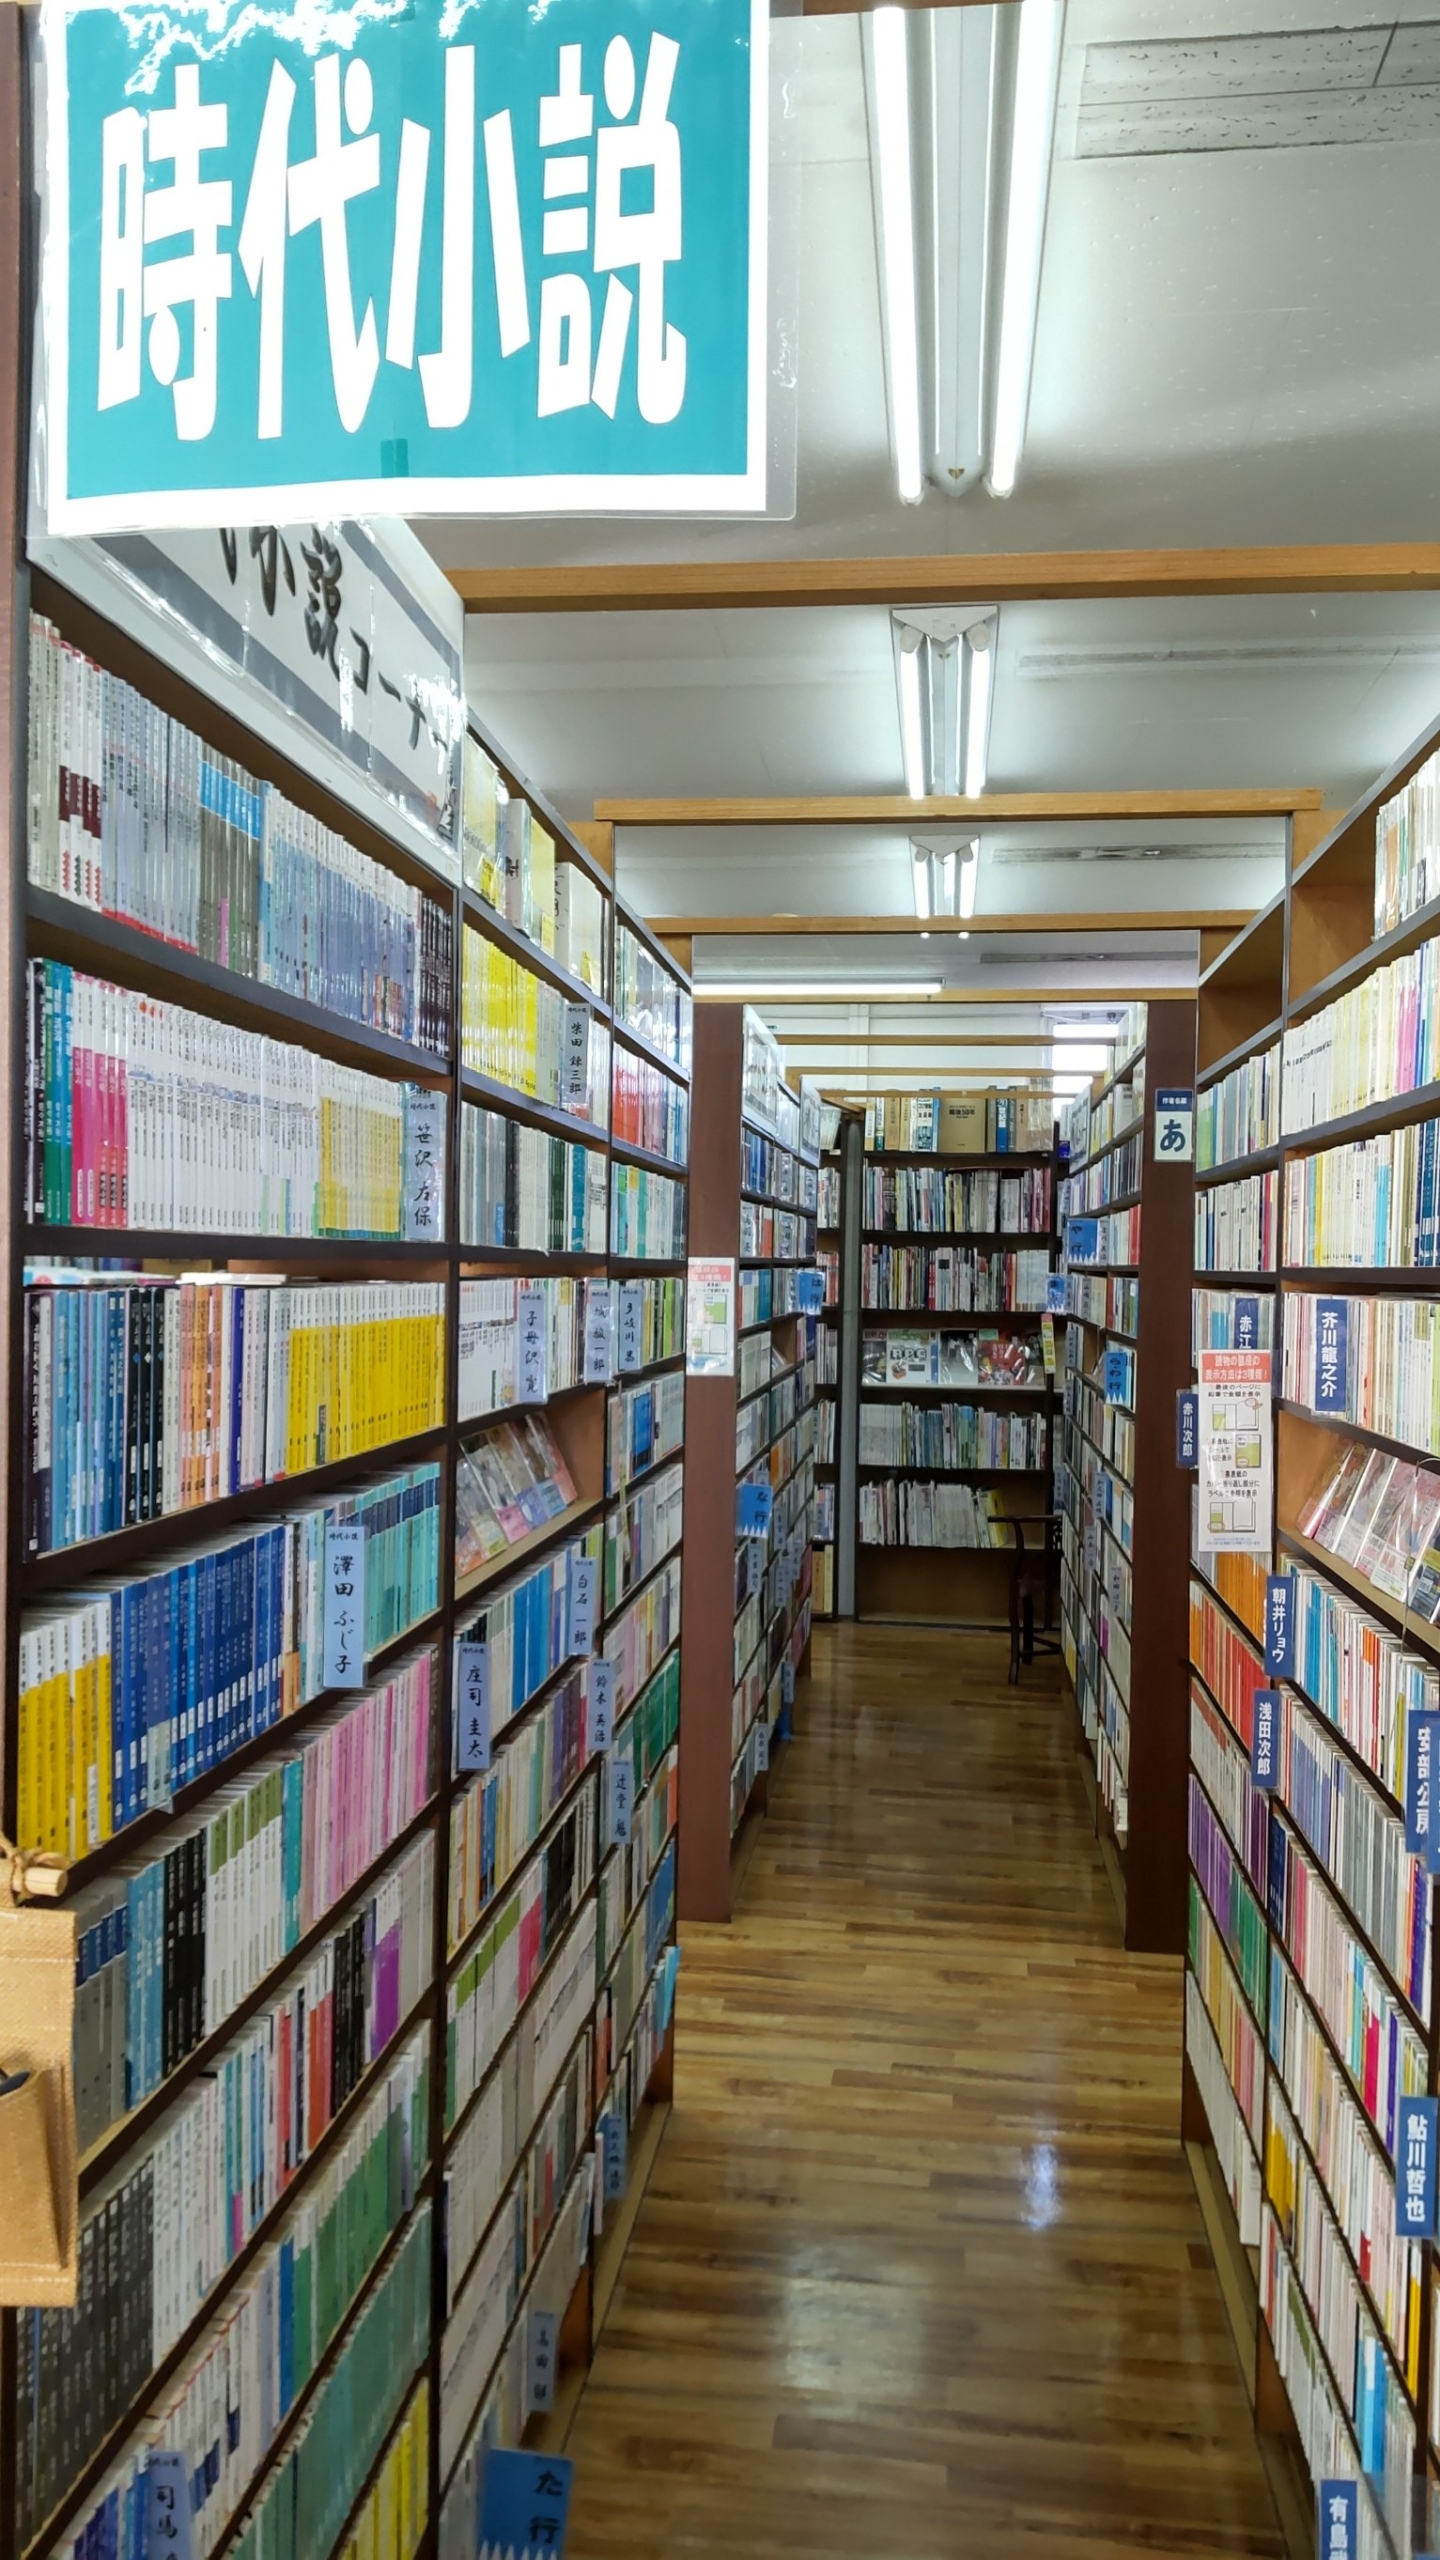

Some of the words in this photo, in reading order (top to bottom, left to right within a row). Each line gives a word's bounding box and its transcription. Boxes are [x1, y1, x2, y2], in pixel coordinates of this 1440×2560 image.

[97, 32, 686, 441] 時代小説
[1160, 1119, 1185, 1152] あ
[414, 1123, 433, 1226] 笹沢左保
[1072, 1224, 1083, 1252] や行
[1239, 1315, 1252, 1349] 赤江
[1321, 1311, 1338, 1398] 芥川龍之介
[1182, 1403, 1193, 1457] 赤川次郎
[754, 1490, 768, 1524] な行
[333, 1555, 355, 1674] 澤田ふじ子
[574, 1574, 588, 1645] 白石一郎
[1271, 1587, 1287, 1664] 朝井リョウ
[466, 1665, 484, 1758] 庄司圭太
[594, 1675, 608, 1744] 鈴木英治
[1257, 1701, 1273, 1776] 浅田次郎
[1405, 2113, 1428, 2223] 鮎川哲也
[156, 2485, 178, 2560] 司馬
[528, 2470, 564, 2545] た行
